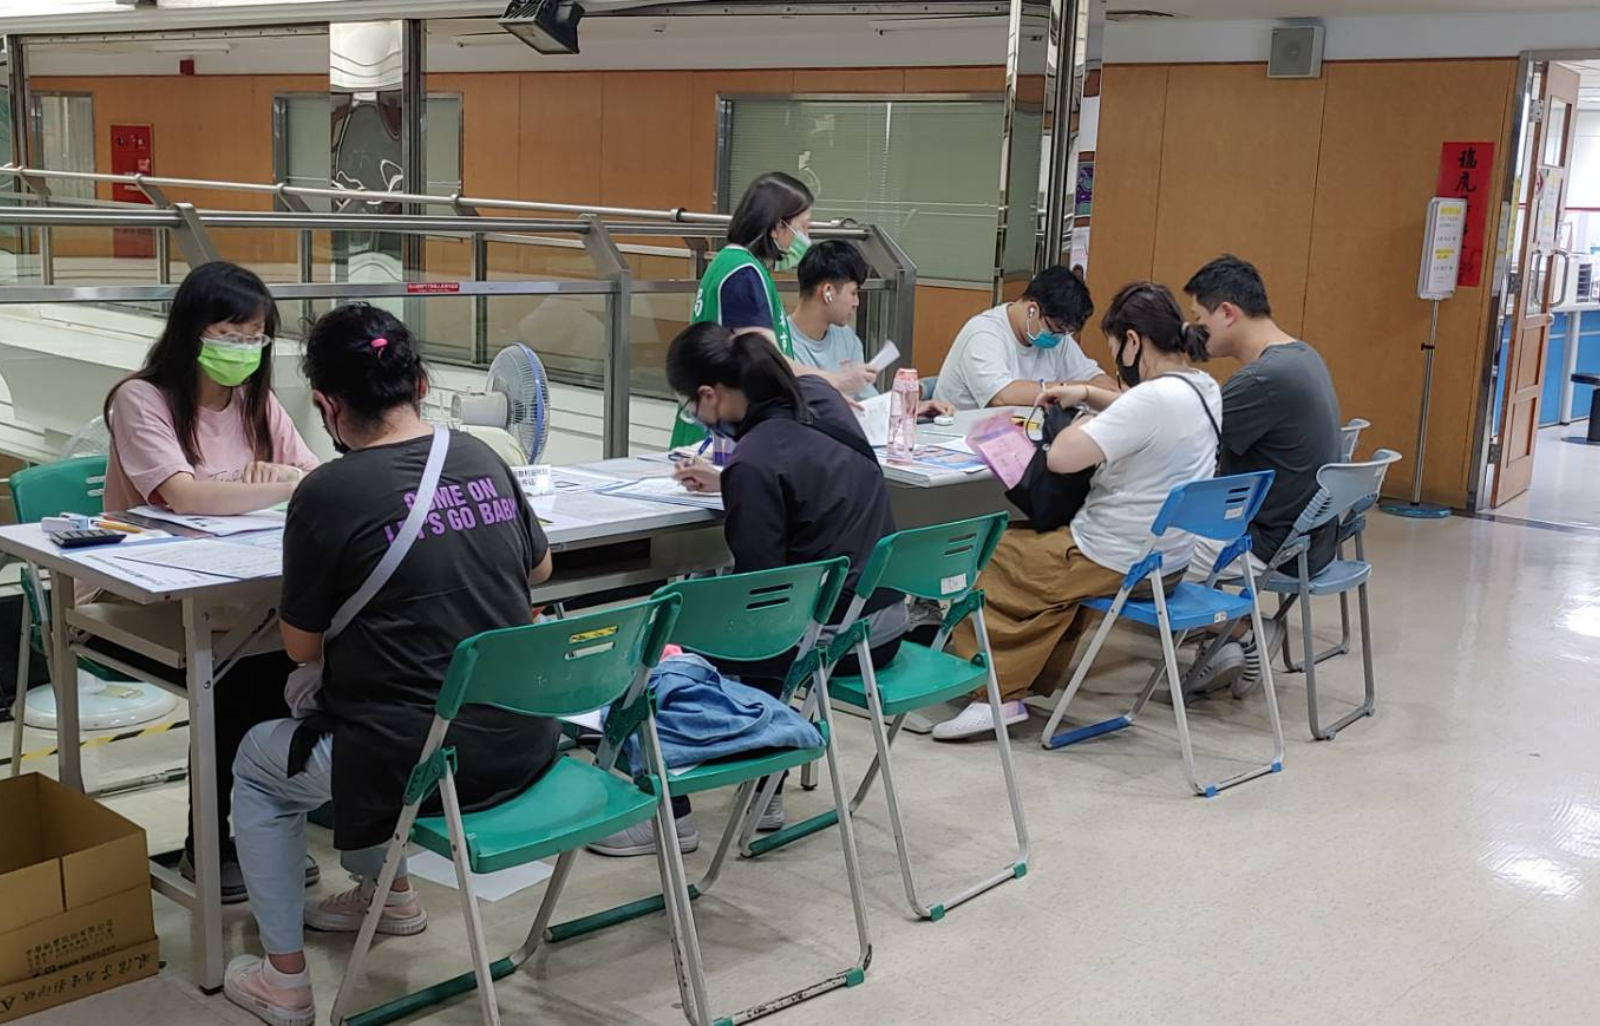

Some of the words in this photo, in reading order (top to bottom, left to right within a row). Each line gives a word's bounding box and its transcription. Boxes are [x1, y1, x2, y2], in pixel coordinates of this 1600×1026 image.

[403, 485, 467, 511] CME
[467, 477, 498, 501] ON
[383, 511, 445, 543] L'S
[447, 506, 476, 531] GO
